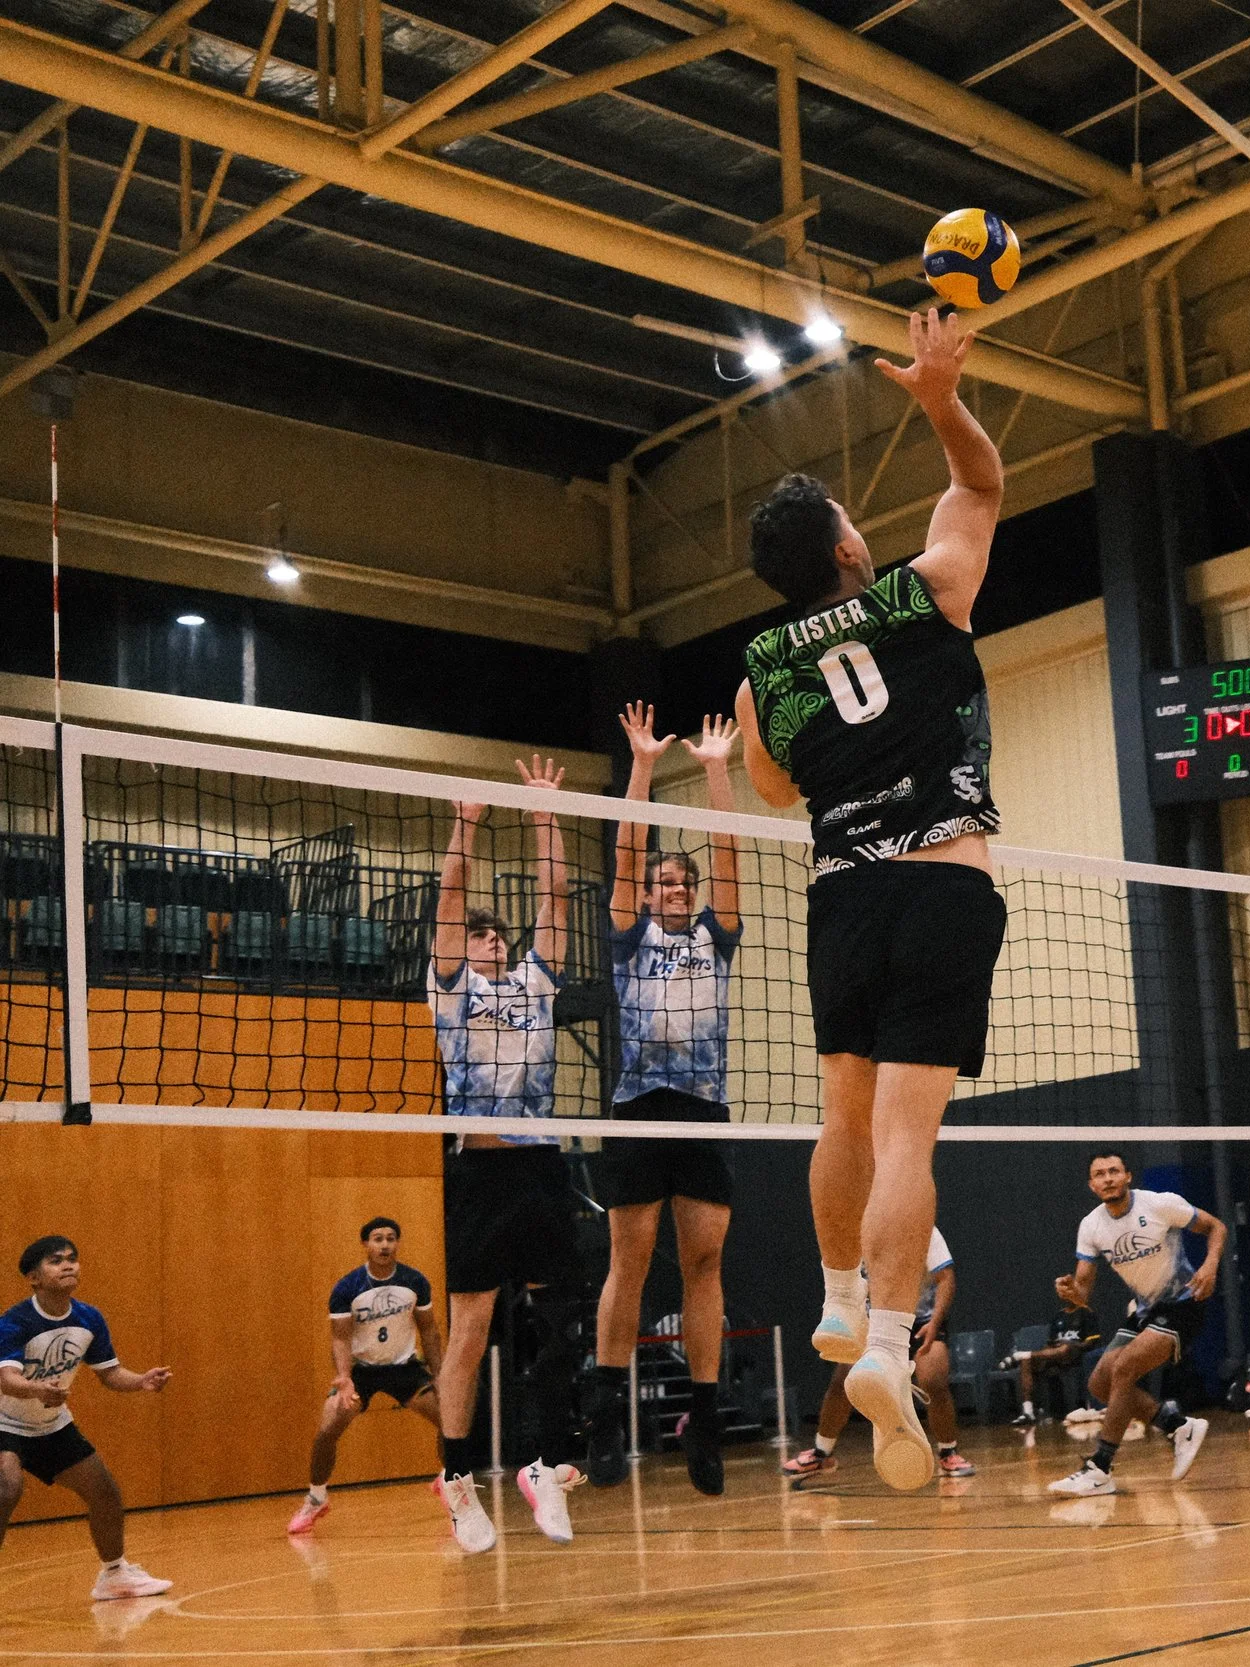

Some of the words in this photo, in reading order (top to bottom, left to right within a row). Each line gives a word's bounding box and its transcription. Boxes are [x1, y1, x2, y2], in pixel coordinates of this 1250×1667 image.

[788, 598, 868, 648] LISTER
[817, 640, 890, 724] 0
[1156, 704, 1187, 717] LIGHT
[1183, 716, 1199, 743] 3
[1176, 759, 1189, 779] 0
[1228, 754, 1241, 772] 0
[847, 819, 882, 836] GAME
[1138, 1215, 1148, 1228] 6
[377, 1326, 389, 1343] 8
